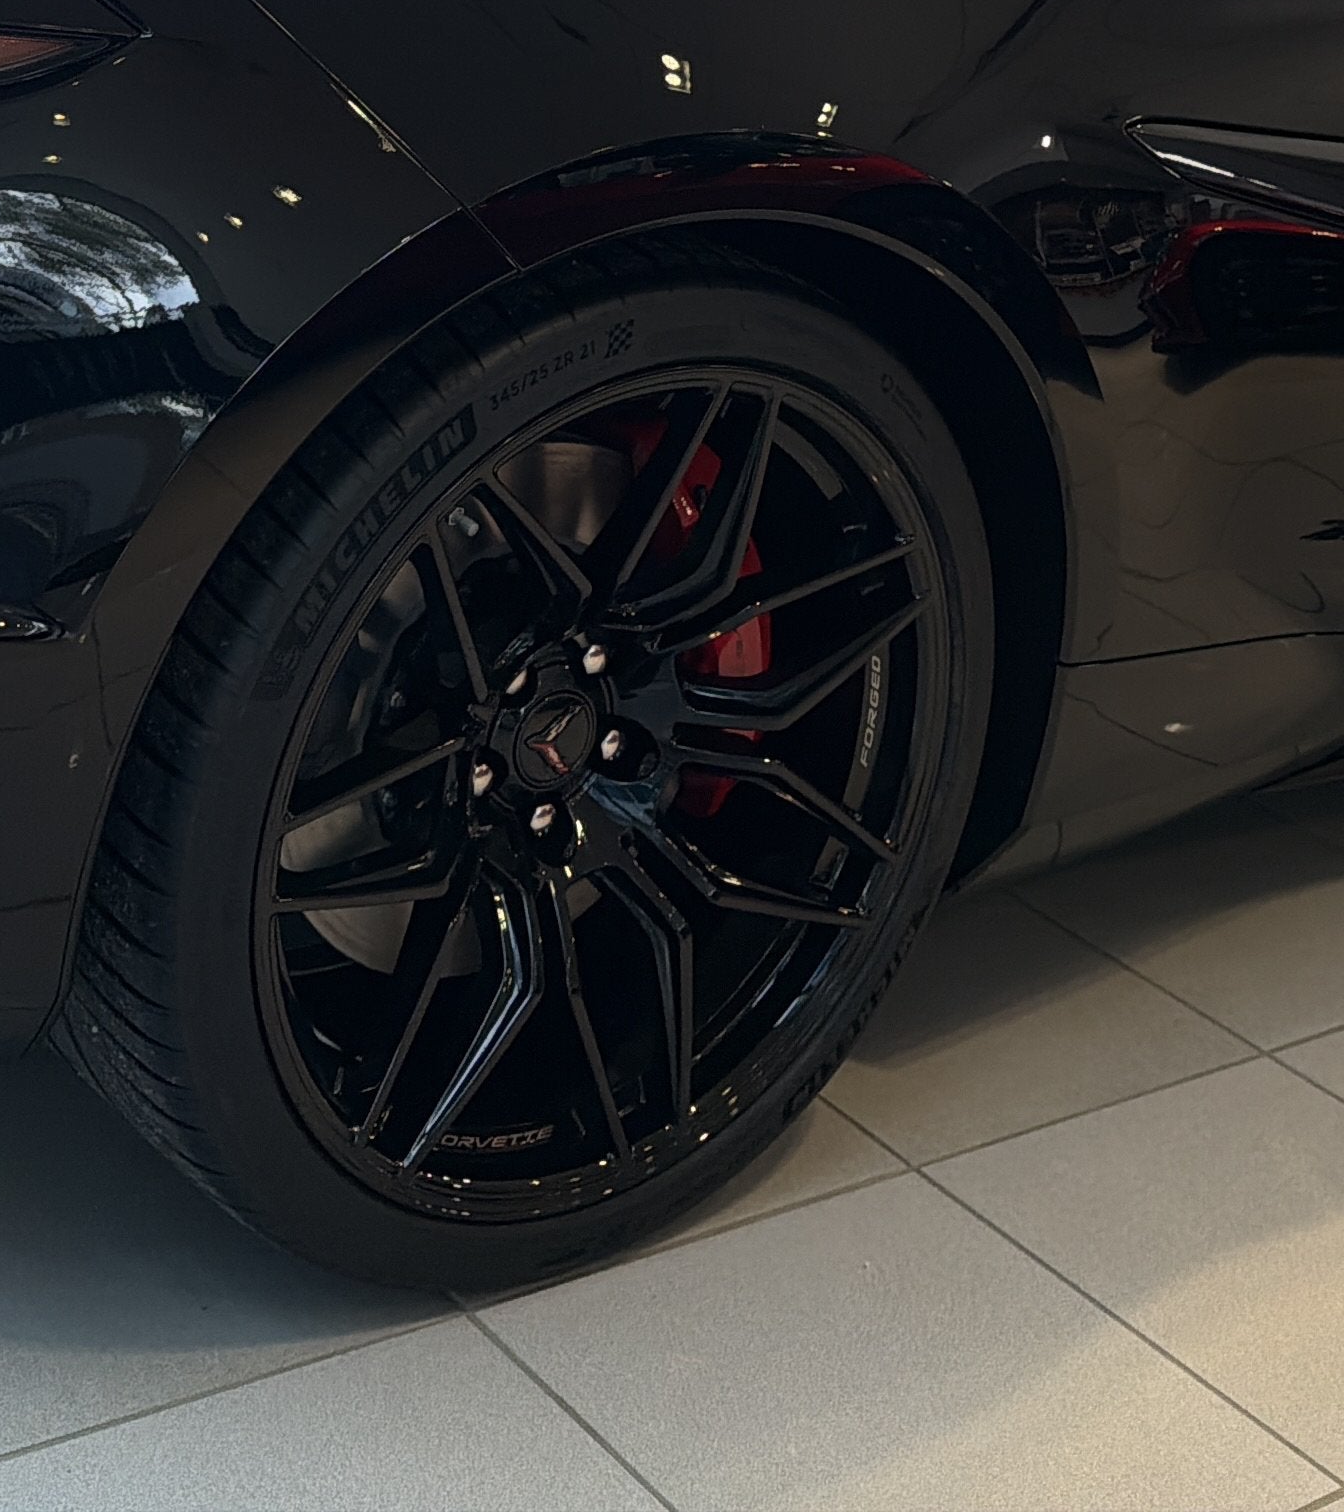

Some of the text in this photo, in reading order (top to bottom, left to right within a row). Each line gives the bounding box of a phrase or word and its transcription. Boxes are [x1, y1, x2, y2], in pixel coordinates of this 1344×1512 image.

[489, 339, 596, 411] 345/25 ZR 21
[292, 408, 476, 632] MICHELIN
[859, 655, 881, 768] FORGED
[441, 1124, 554, 1150] ORVETTE
